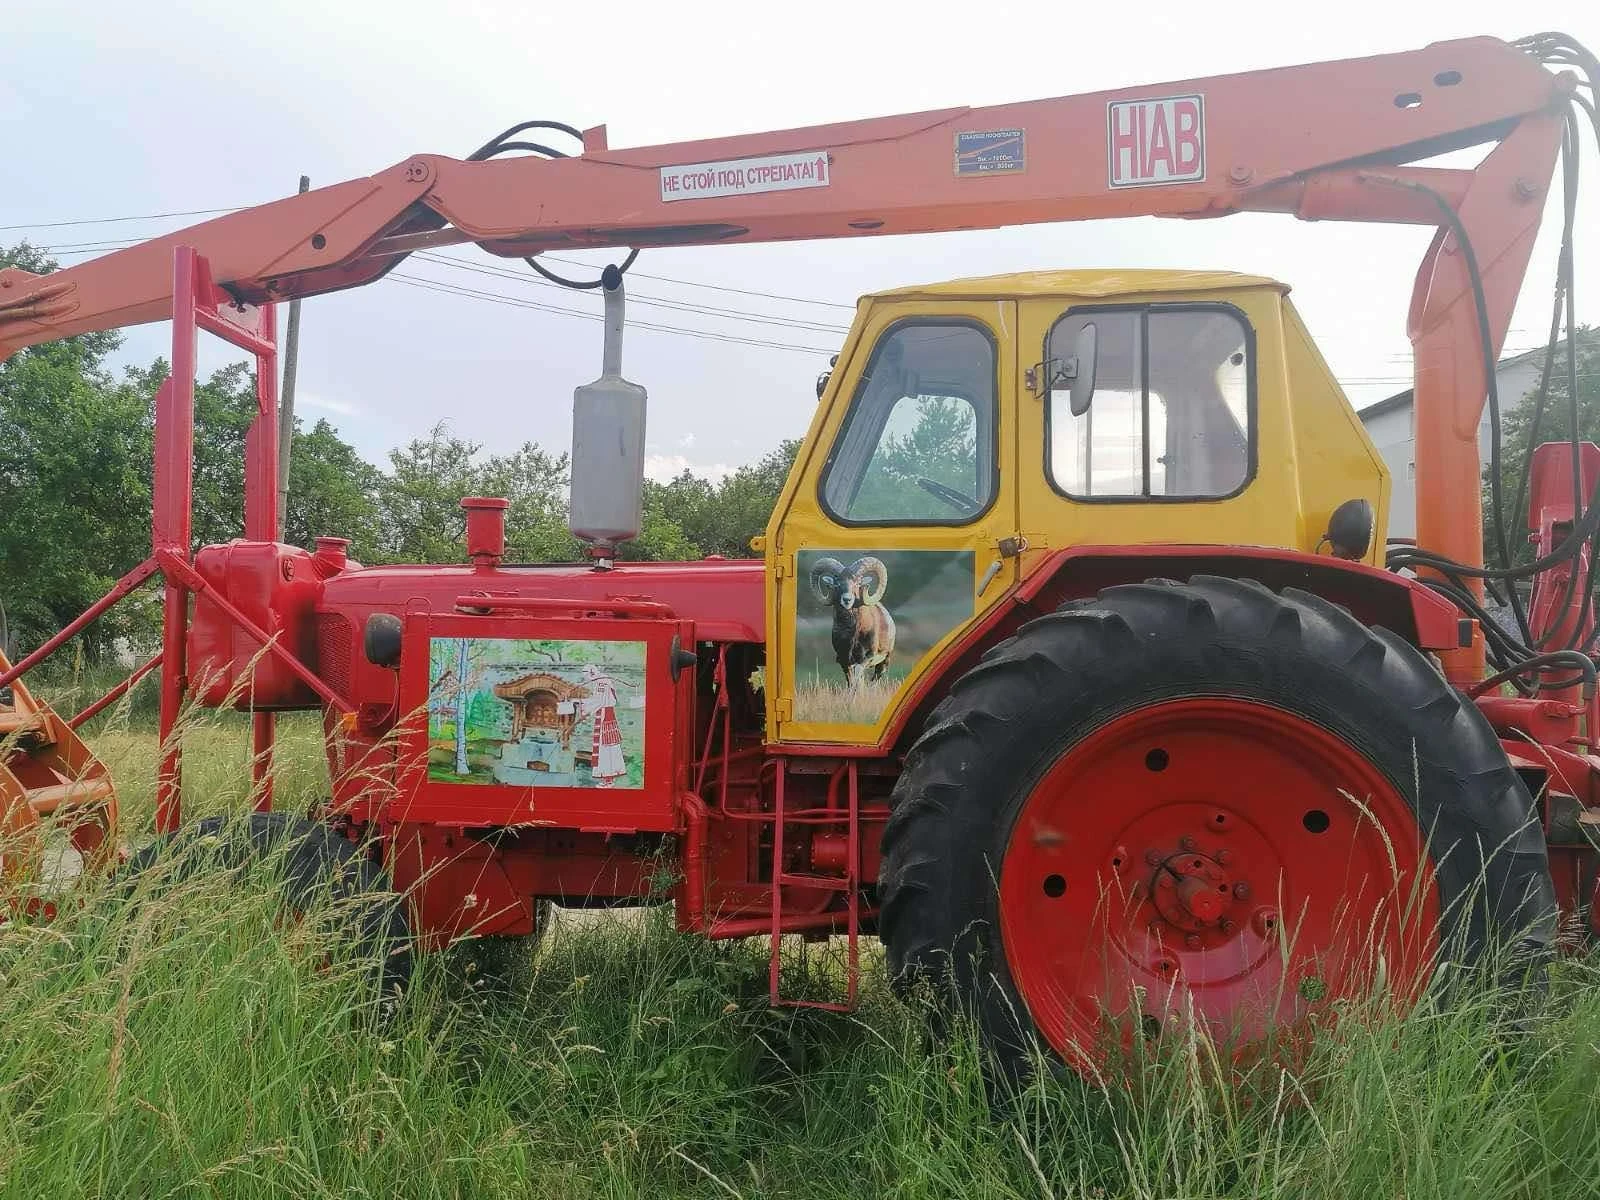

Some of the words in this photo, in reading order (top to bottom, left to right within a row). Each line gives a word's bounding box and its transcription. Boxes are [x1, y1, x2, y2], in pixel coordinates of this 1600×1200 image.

[1113, 101, 1200, 180] HIAB
[663, 175, 680, 192] НЕ
[682, 169, 716, 190] СТОЙ
[718, 169, 746, 188] ПОД
